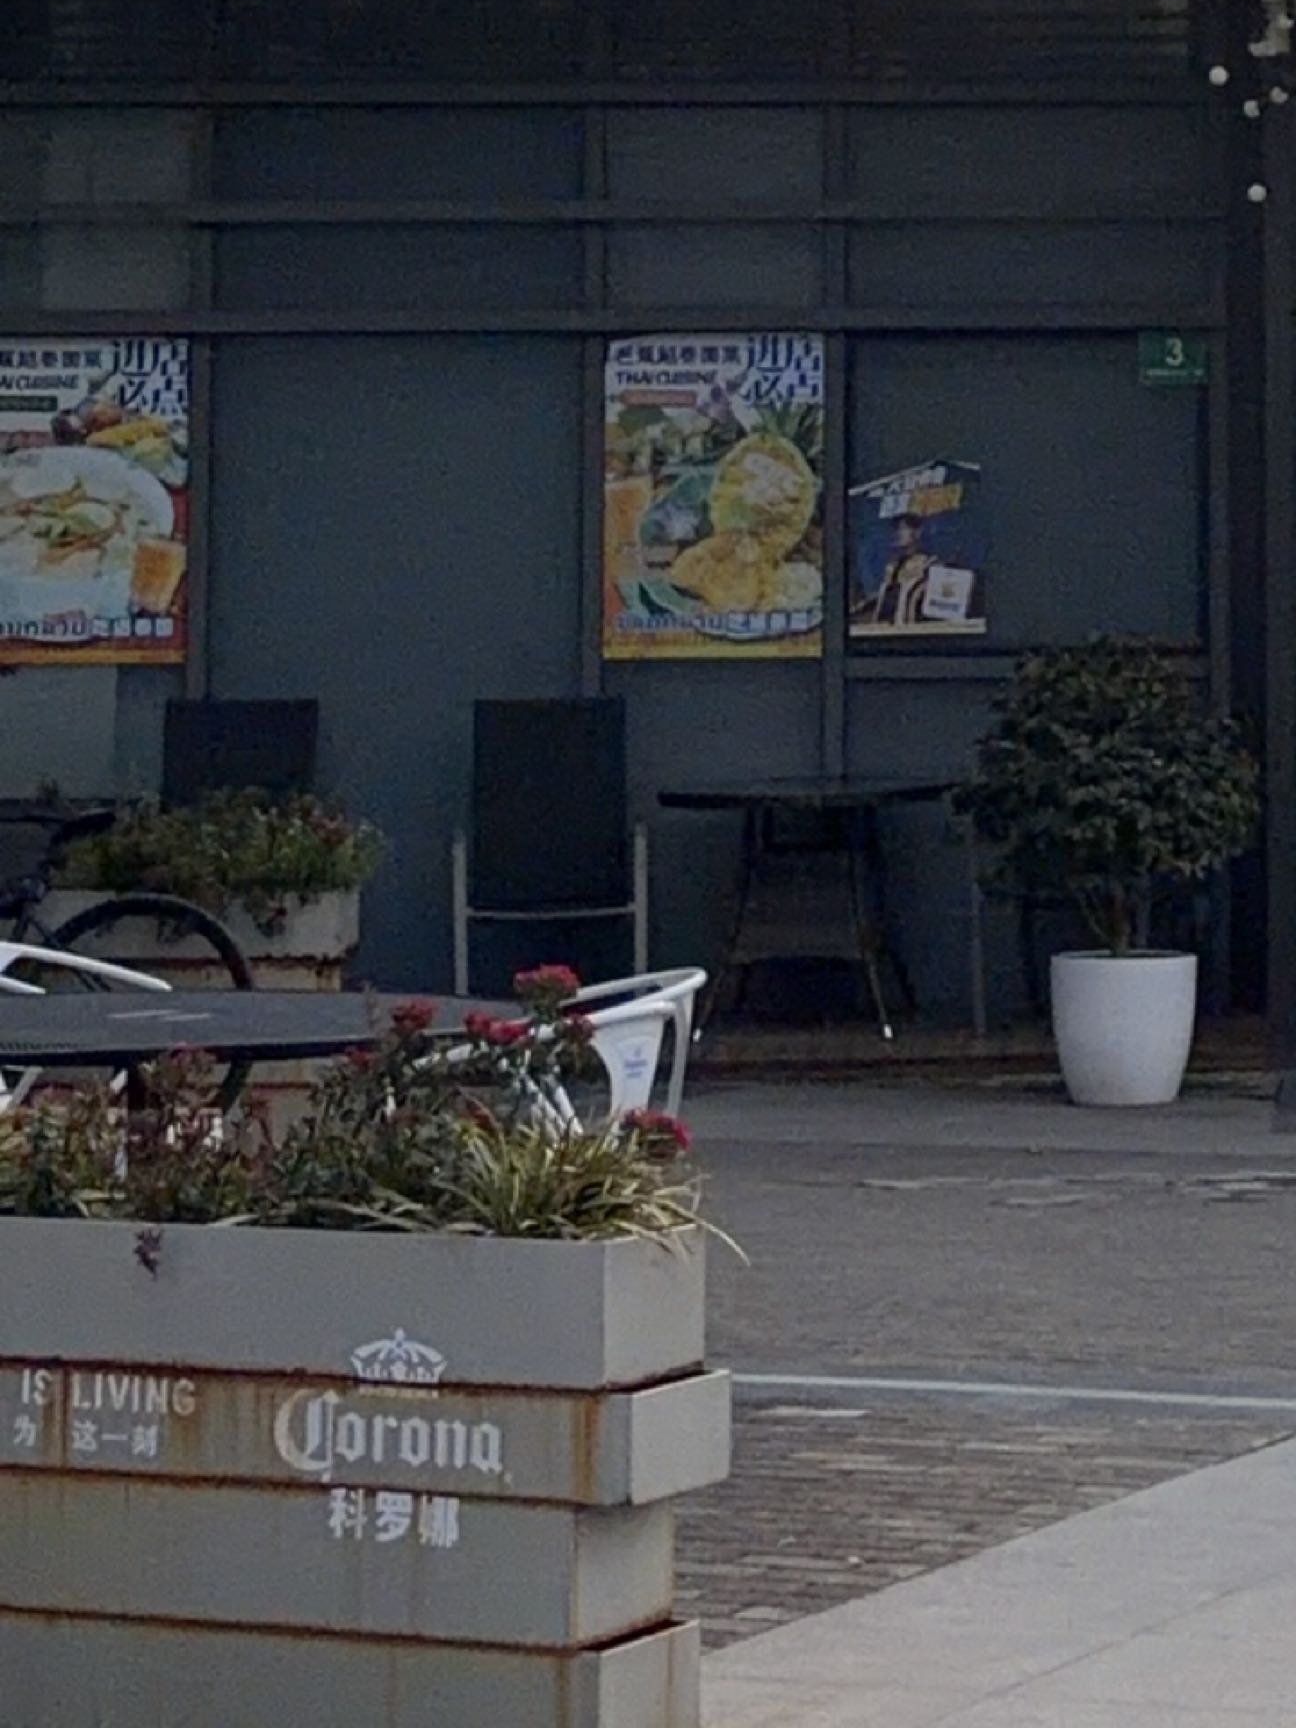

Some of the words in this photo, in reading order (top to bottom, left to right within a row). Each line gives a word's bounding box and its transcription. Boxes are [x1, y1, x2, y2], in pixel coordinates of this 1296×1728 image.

[1166, 337, 1183, 366] 3
[22, 1368, 52, 1405] IS
[71, 1373, 197, 1416] LIVING
[13, 1415, 38, 1447] 为
[71, 1419, 159, 1456] 这一刻
[273, 1387, 503, 1483] Corona
[328, 1487, 461, 1548] 科罗娜
